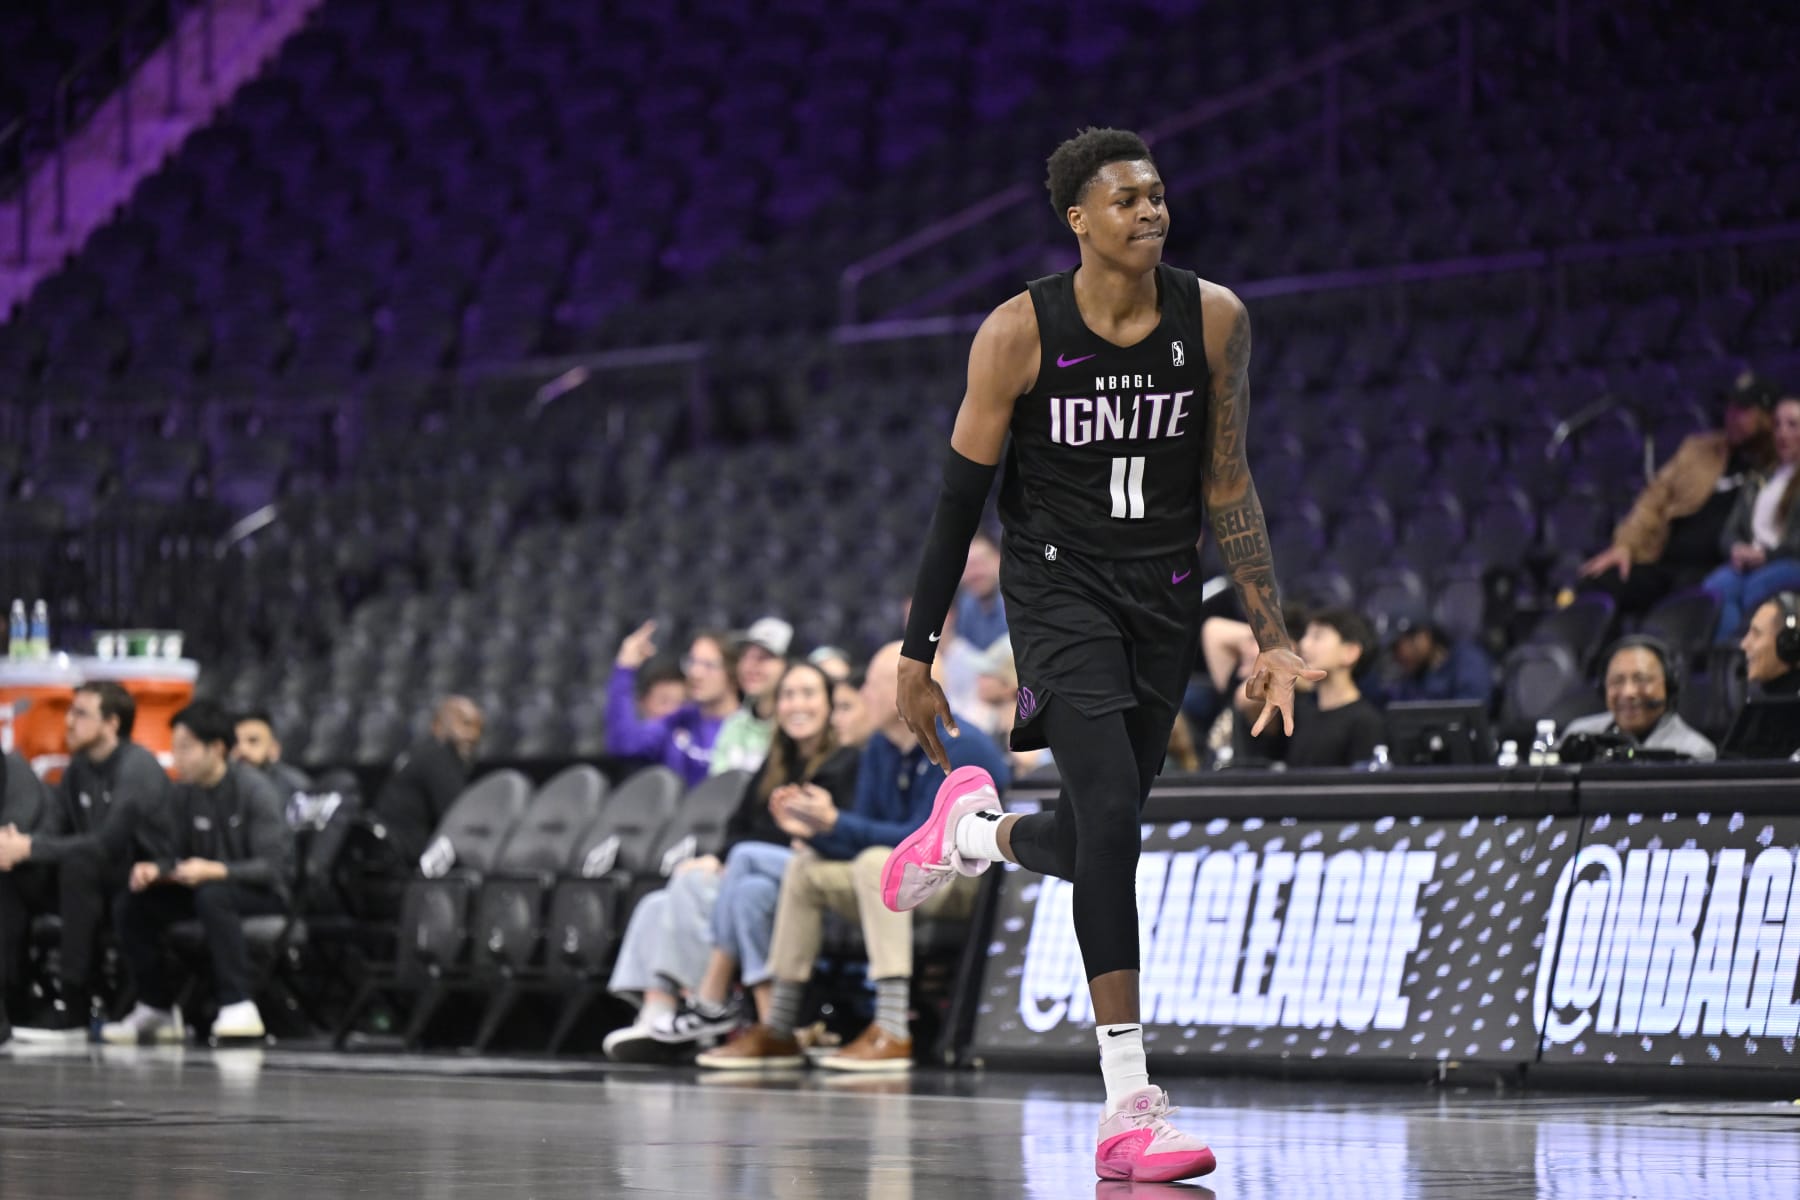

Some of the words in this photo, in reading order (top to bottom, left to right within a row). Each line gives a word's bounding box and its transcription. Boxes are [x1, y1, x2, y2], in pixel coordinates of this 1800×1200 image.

[1095, 374, 1155, 391] NBAGL
[1050, 389, 1194, 446] IGNITE
[1109, 456, 1146, 519] 11
[1215, 506, 1252, 539] SELF
[1020, 849, 1437, 1032] @BAGLEAGUE
